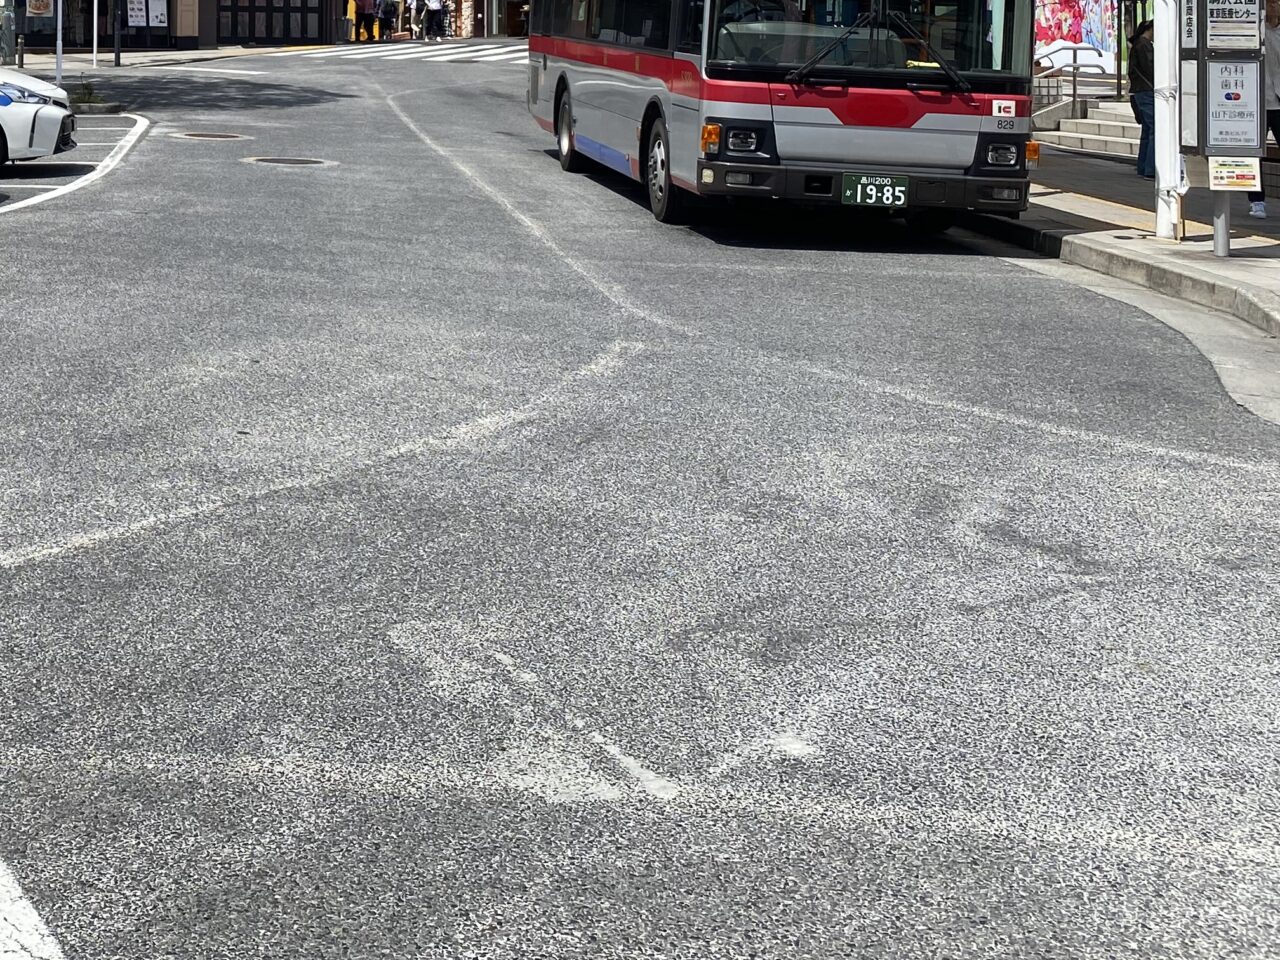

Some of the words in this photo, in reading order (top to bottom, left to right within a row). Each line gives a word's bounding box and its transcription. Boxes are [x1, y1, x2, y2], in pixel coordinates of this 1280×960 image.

[1208, 8, 1257, 19] 東京医療センター
[1220, 65, 1245, 76] 内科
[1220, 79, 1245, 90] 歯科
[1211, 111, 1255, 120] 山下診療所
[997, 119, 1015, 130] 829
[856, 184, 906, 205] 19-85
